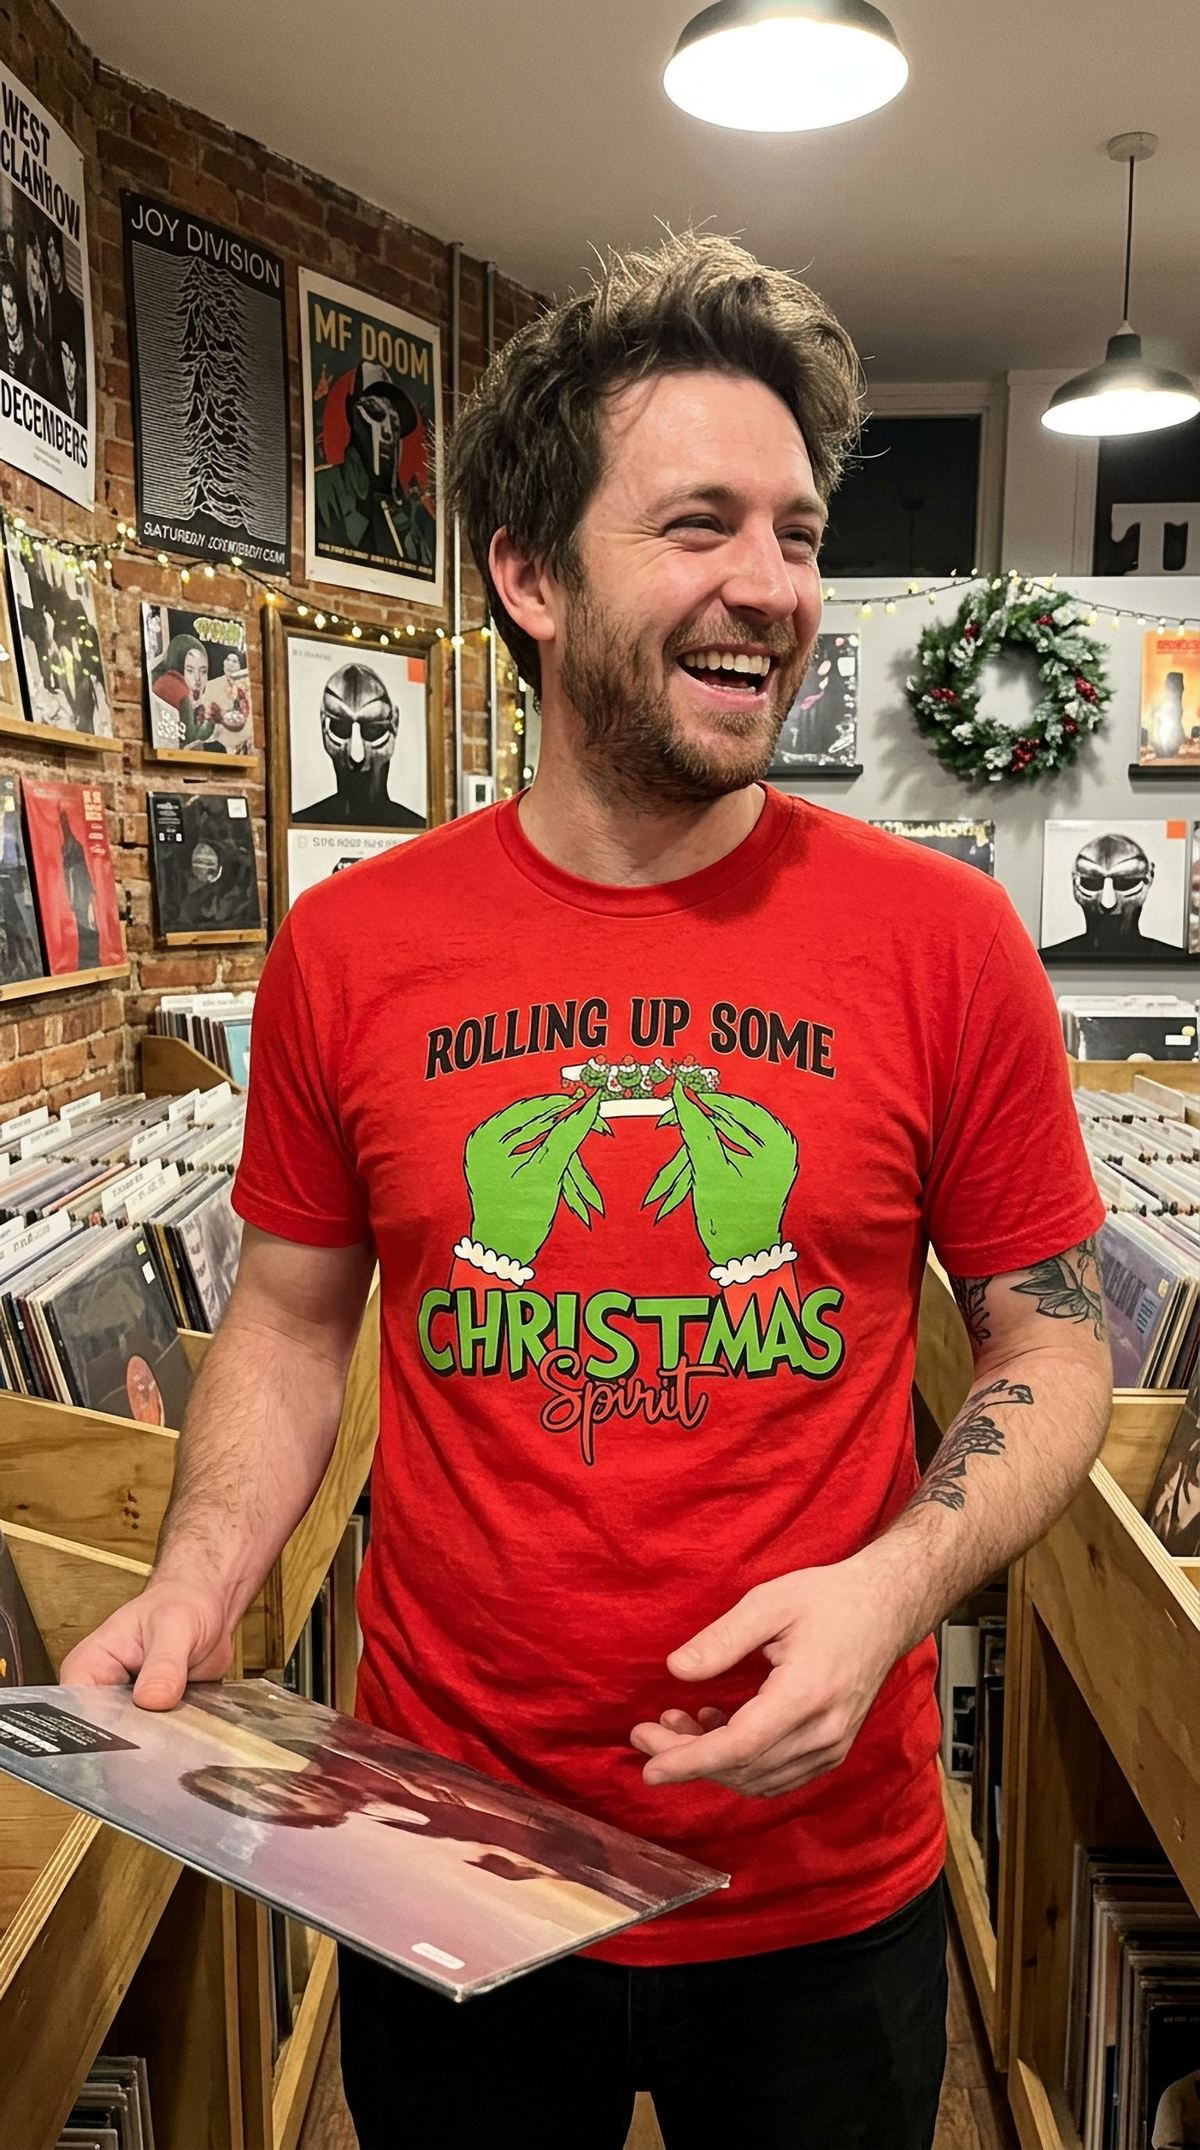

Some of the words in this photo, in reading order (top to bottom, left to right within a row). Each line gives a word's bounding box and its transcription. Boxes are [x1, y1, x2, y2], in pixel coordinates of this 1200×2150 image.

[2, 81, 50, 167] WEST
[131, 205, 180, 242] JOY
[187, 223, 280, 289] DIVISION
[314, 303, 352, 352] MF
[361, 321, 429, 386] DOOM
[424, 996, 608, 1081] ROLLING
[629, 996, 691, 1048] UP
[709, 1001, 836, 1078] SOME
[417, 1286, 846, 1383] CHRISTMAS
[539, 1346, 727, 1467] Spirit
